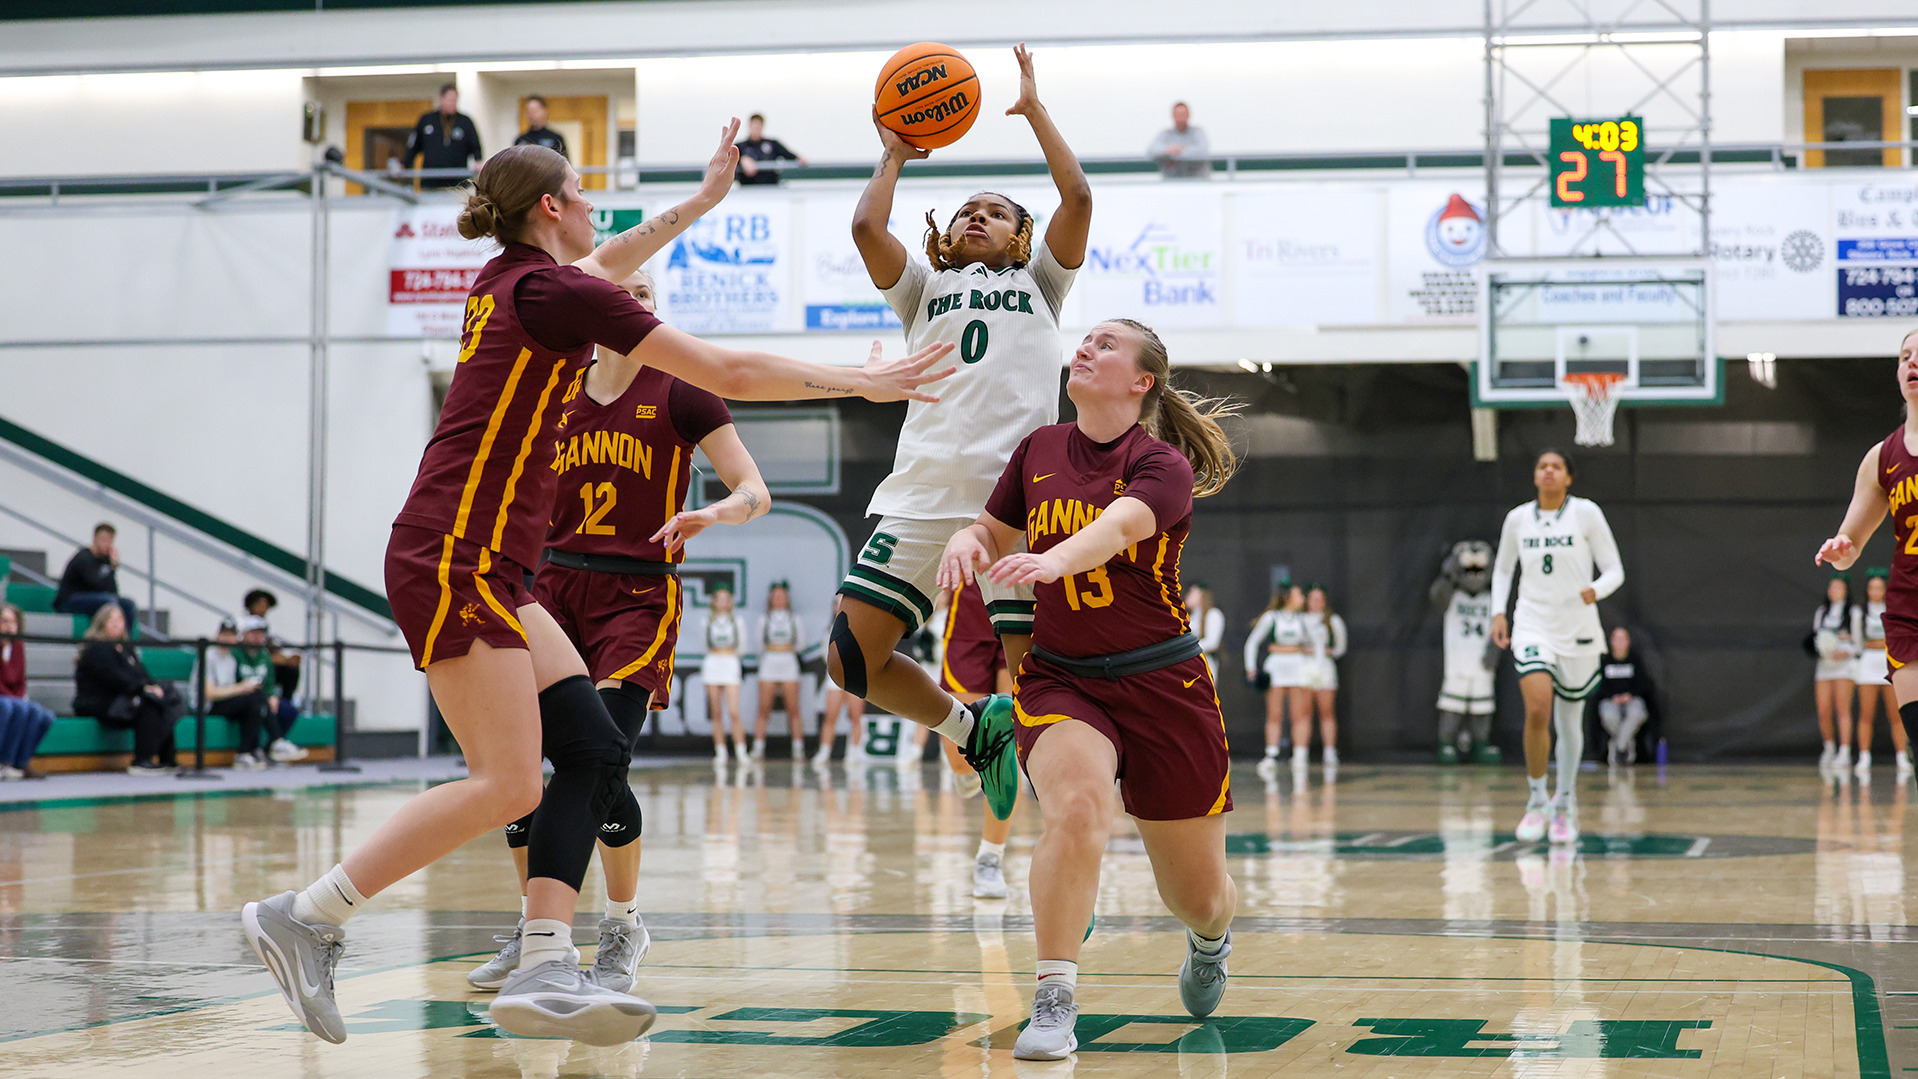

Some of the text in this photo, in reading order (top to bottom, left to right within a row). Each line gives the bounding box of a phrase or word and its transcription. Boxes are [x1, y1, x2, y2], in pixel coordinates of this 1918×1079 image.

[896, 64, 948, 97] NCAA
[900, 91, 970, 125] Wilson
[1572, 120, 1638, 152] 4:03
[1556, 151, 1627, 202] 27
[726, 215, 770, 241] RB
[1089, 247, 1215, 273] NexTier
[927, 292, 963, 322] THE
[969, 289, 1034, 315] ROCK
[1144, 280, 1216, 305] Bank
[960, 319, 989, 364] 0
[550, 430, 653, 480] GANNON
[575, 481, 617, 536] 12
[862, 533, 899, 565] S
[1523, 535, 1573, 548] THE ROCK
[1542, 553, 1553, 575] 8
[1063, 564, 1115, 611] 13
[866, 721, 900, 756] R
